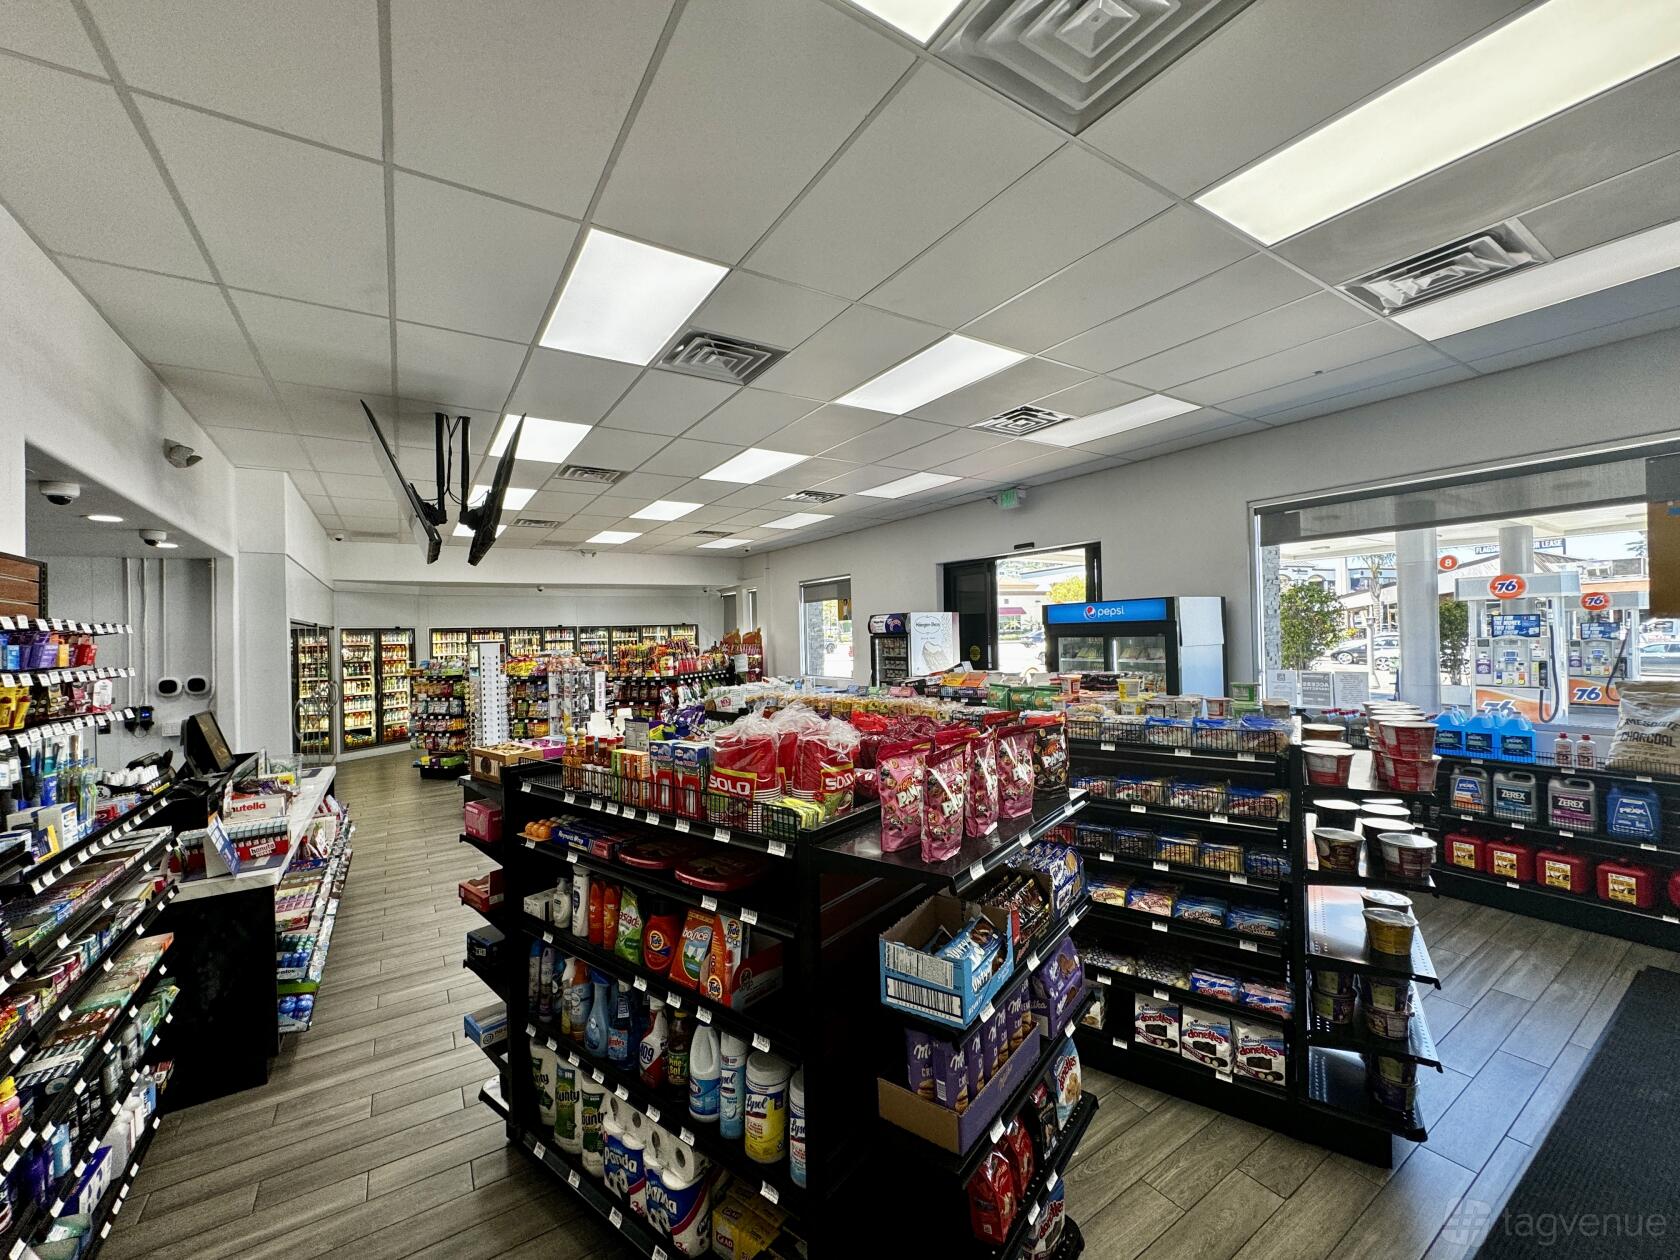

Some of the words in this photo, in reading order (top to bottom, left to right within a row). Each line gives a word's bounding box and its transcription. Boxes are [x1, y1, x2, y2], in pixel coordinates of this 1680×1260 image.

[1542, 539, 1563, 548] LEASE
[1495, 580, 1518, 593] 76
[1586, 596, 1604, 606] 76
[1097, 605, 1125, 618] pepsi
[1573, 686, 1602, 701] 76
[1620, 731, 1676, 748] CHARCOAL
[709, 774, 751, 796] SOLO
[896, 784, 922, 808] PAN
[1502, 789, 1526, 800] ZEREX
[1558, 798, 1585, 809] ZEREX
[619, 911, 642, 929] ascade
[682, 927, 709, 941] bounce
[1140, 1013, 1173, 1025] donettes
[1187, 1029, 1224, 1045] donettes
[1240, 1044, 1278, 1058] donettes
[720, 1072, 737, 1086] ysol
[556, 1089, 580, 1104] ounty
[746, 1094, 768, 1112] Lysol
[603, 1146, 638, 1174] panda
